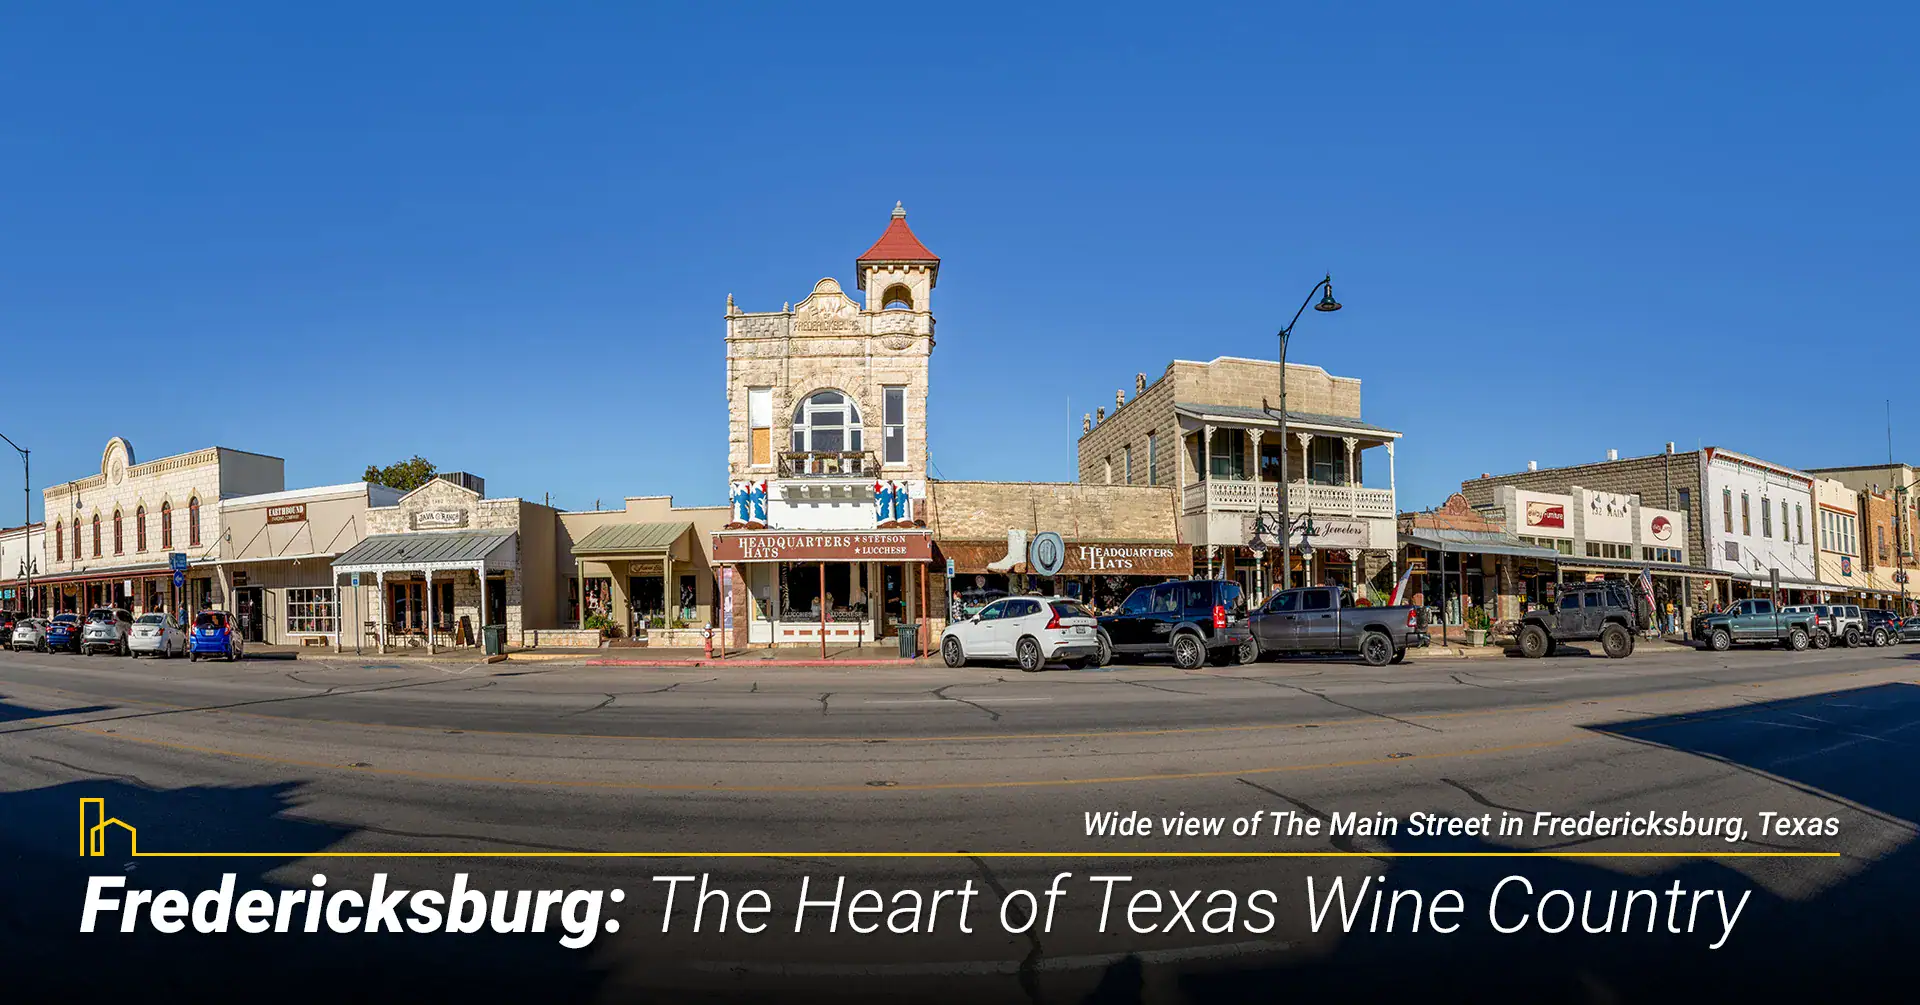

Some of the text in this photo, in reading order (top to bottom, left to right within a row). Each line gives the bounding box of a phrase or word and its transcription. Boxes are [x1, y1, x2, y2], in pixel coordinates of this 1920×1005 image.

[418, 512, 435, 522] JAVA
[1321, 522, 1362, 537] Jewelers
[738, 535, 906, 549] HEADQUARTERS STETSON
[743, 544, 907, 558] HATS LUCCHESE
[1079, 546, 1174, 560] HEADQUARTERS
[1089, 556, 1133, 570] HATS
